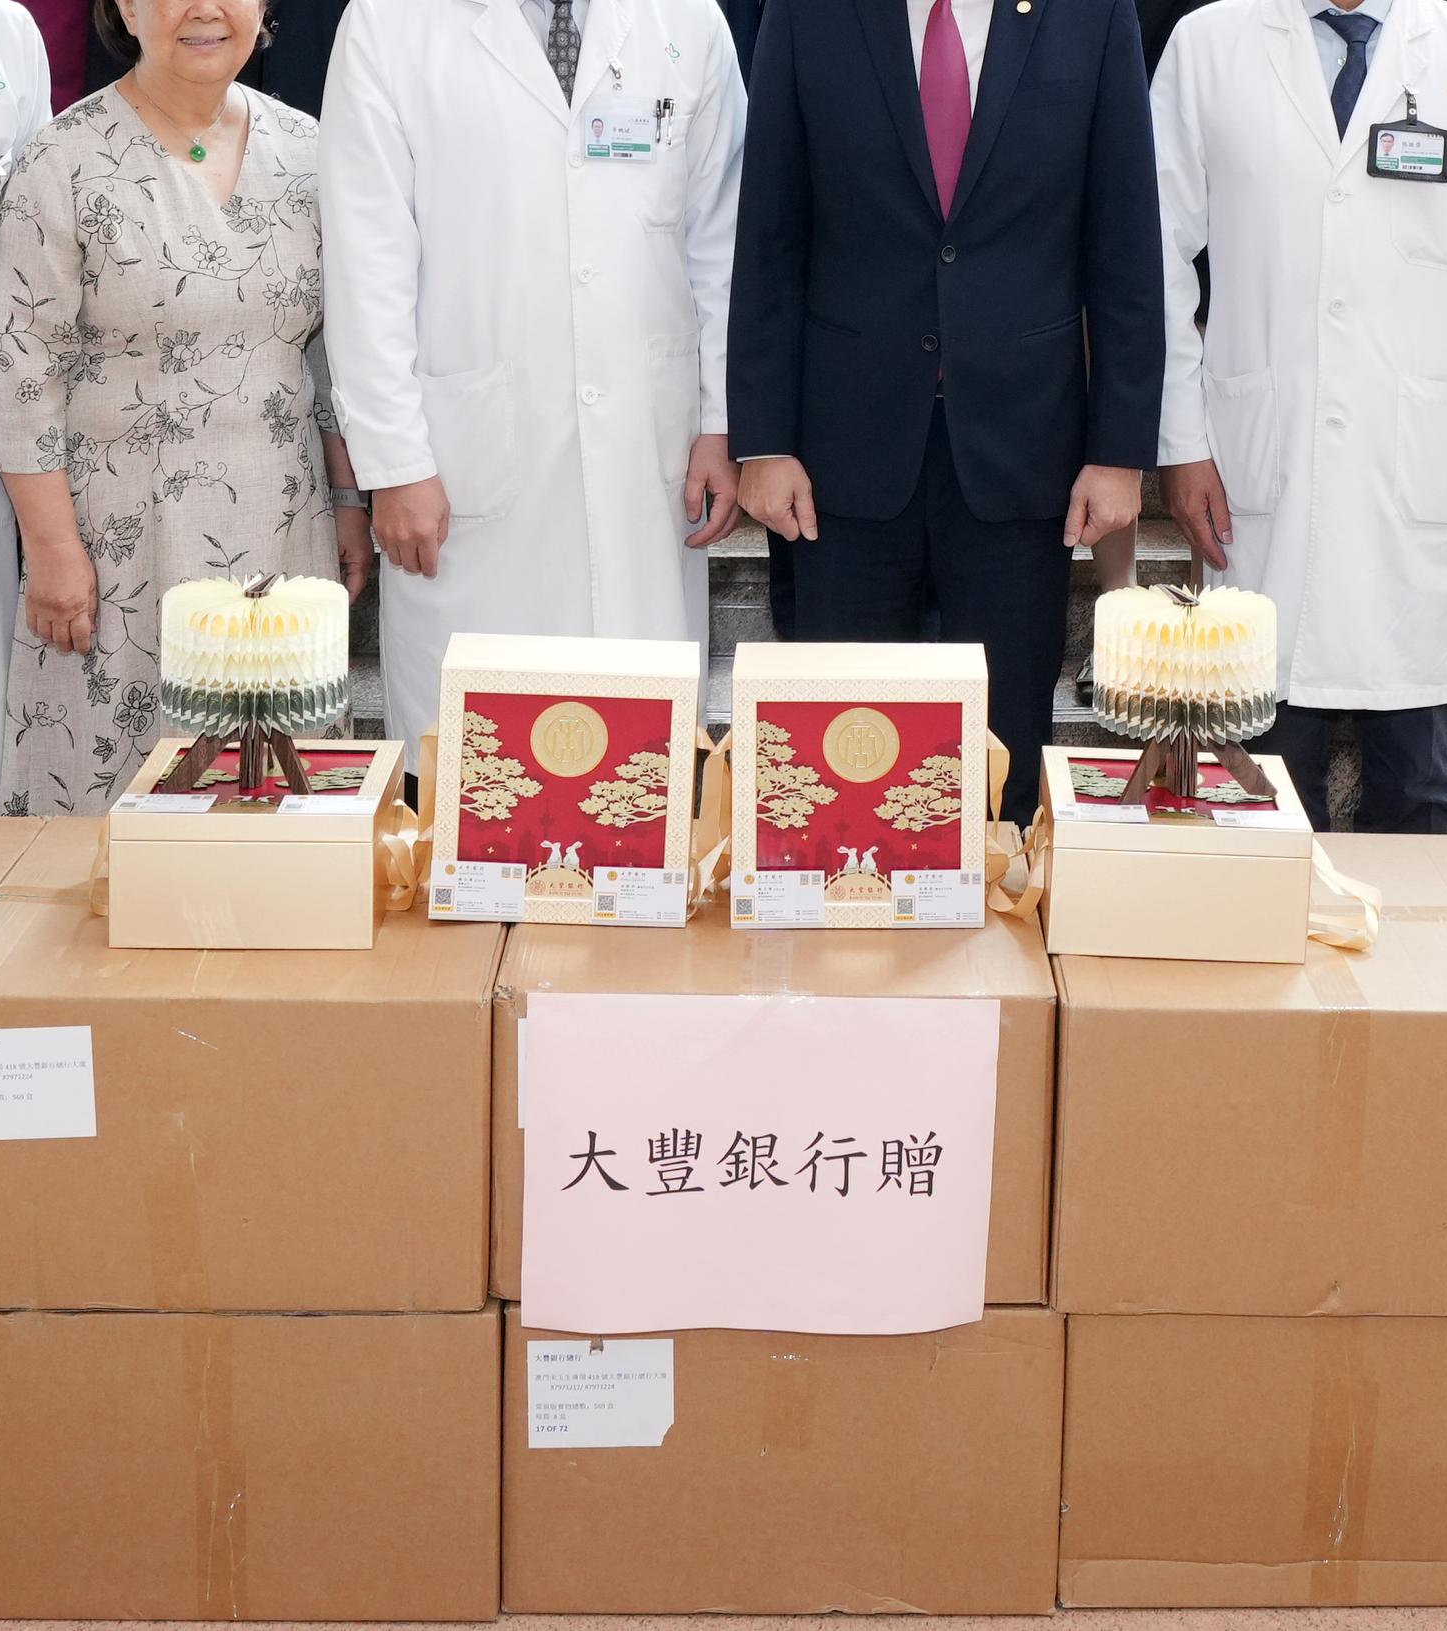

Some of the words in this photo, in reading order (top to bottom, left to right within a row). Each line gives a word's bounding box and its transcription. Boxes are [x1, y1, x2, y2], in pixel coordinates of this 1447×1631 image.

[561, 1128, 943, 1198] 大豐銀行贈
